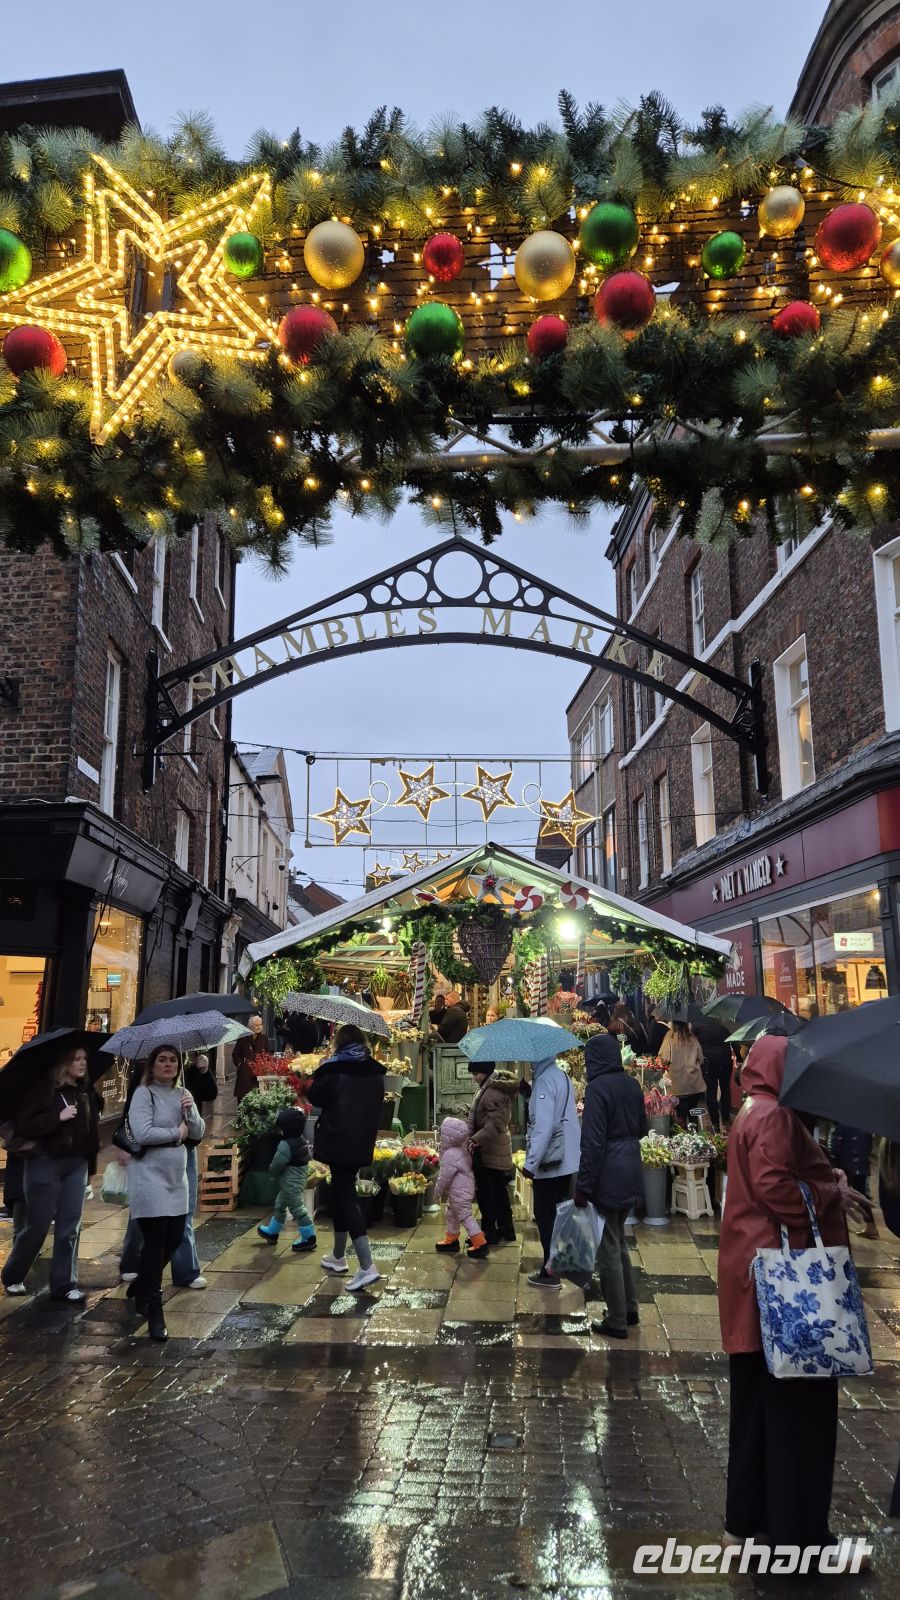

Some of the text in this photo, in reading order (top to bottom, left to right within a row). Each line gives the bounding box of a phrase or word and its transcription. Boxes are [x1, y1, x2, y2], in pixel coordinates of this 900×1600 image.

[188, 607, 711, 699] SHAMBLES MARKET
[720, 855, 772, 902] PRET A MANGER
[726, 970, 745, 988] MADE
